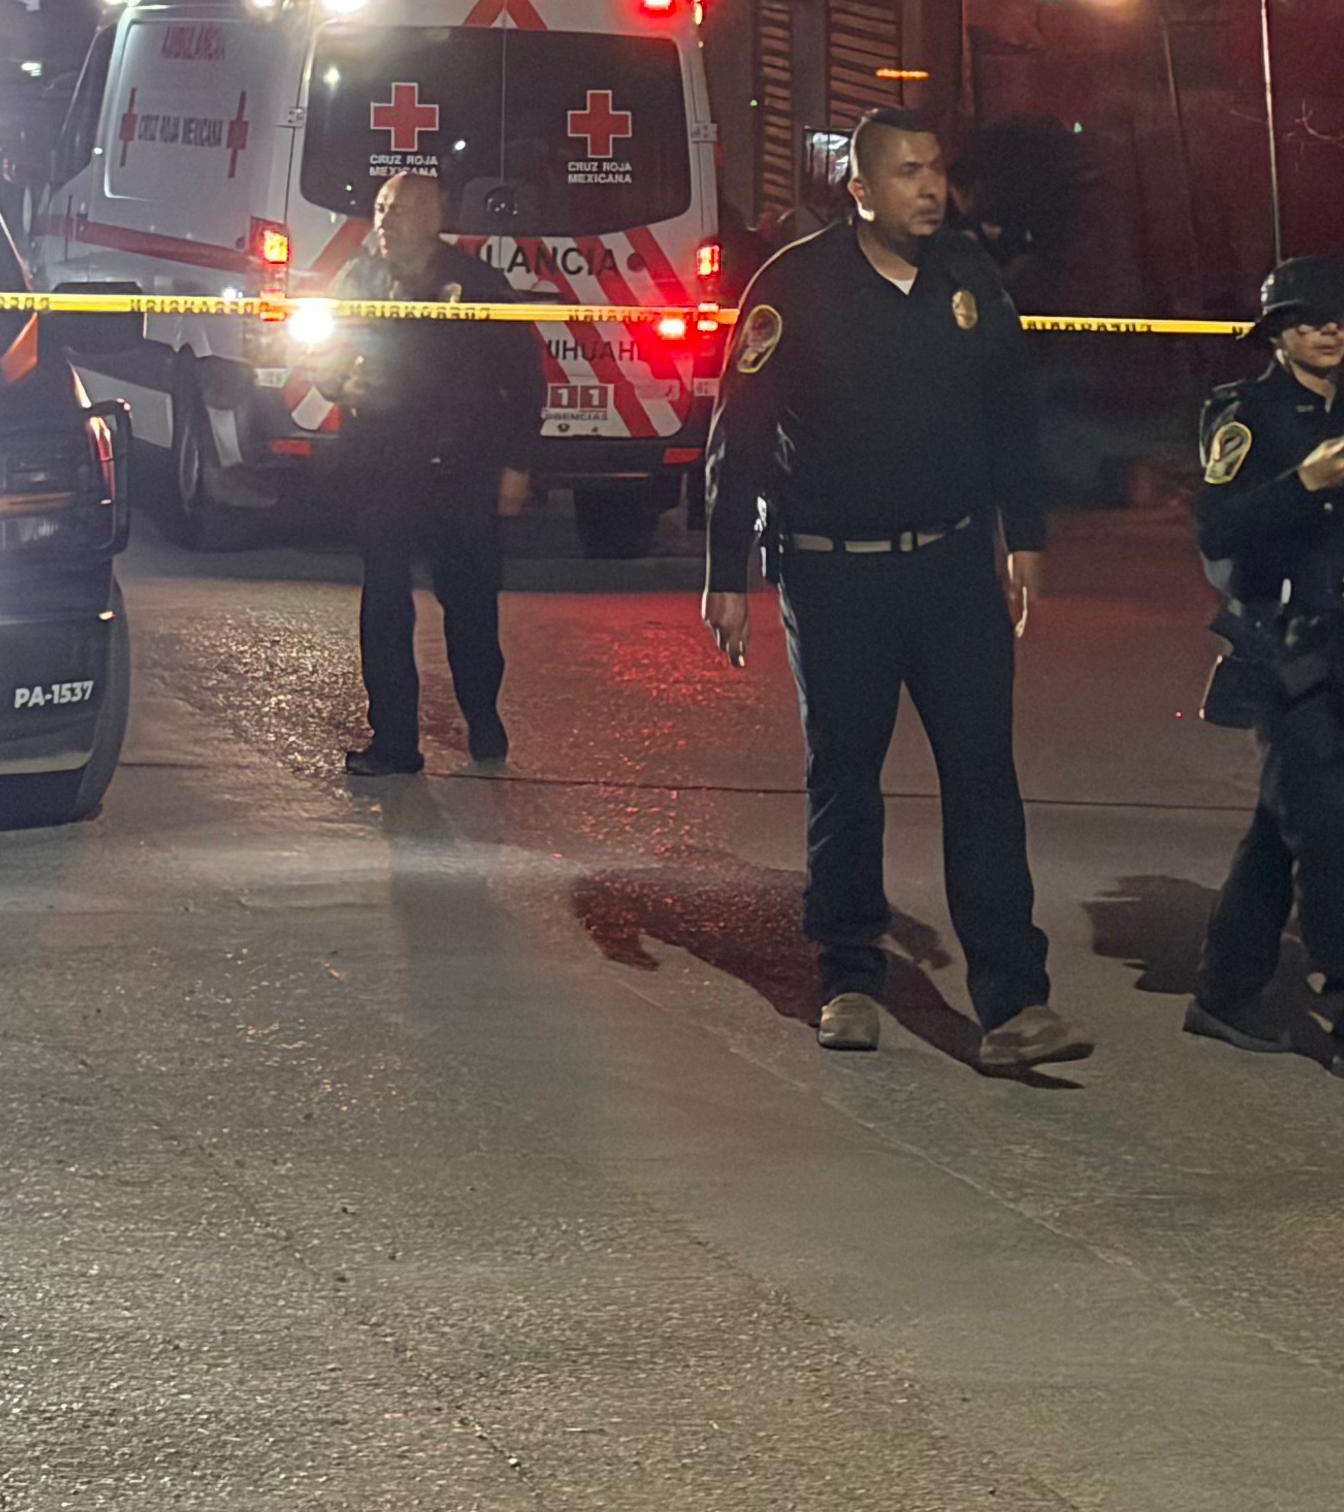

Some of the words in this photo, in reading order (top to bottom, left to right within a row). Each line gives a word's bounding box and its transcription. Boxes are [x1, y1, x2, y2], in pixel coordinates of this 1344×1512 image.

[369, 153, 402, 165] CRUZ
[406, 155, 438, 166] ROJA
[567, 161, 599, 173] CRUZ
[602, 161, 633, 173] ROJA
[567, 173, 633, 185] MEXICANA
[14, 680, 94, 709] PA-1537
